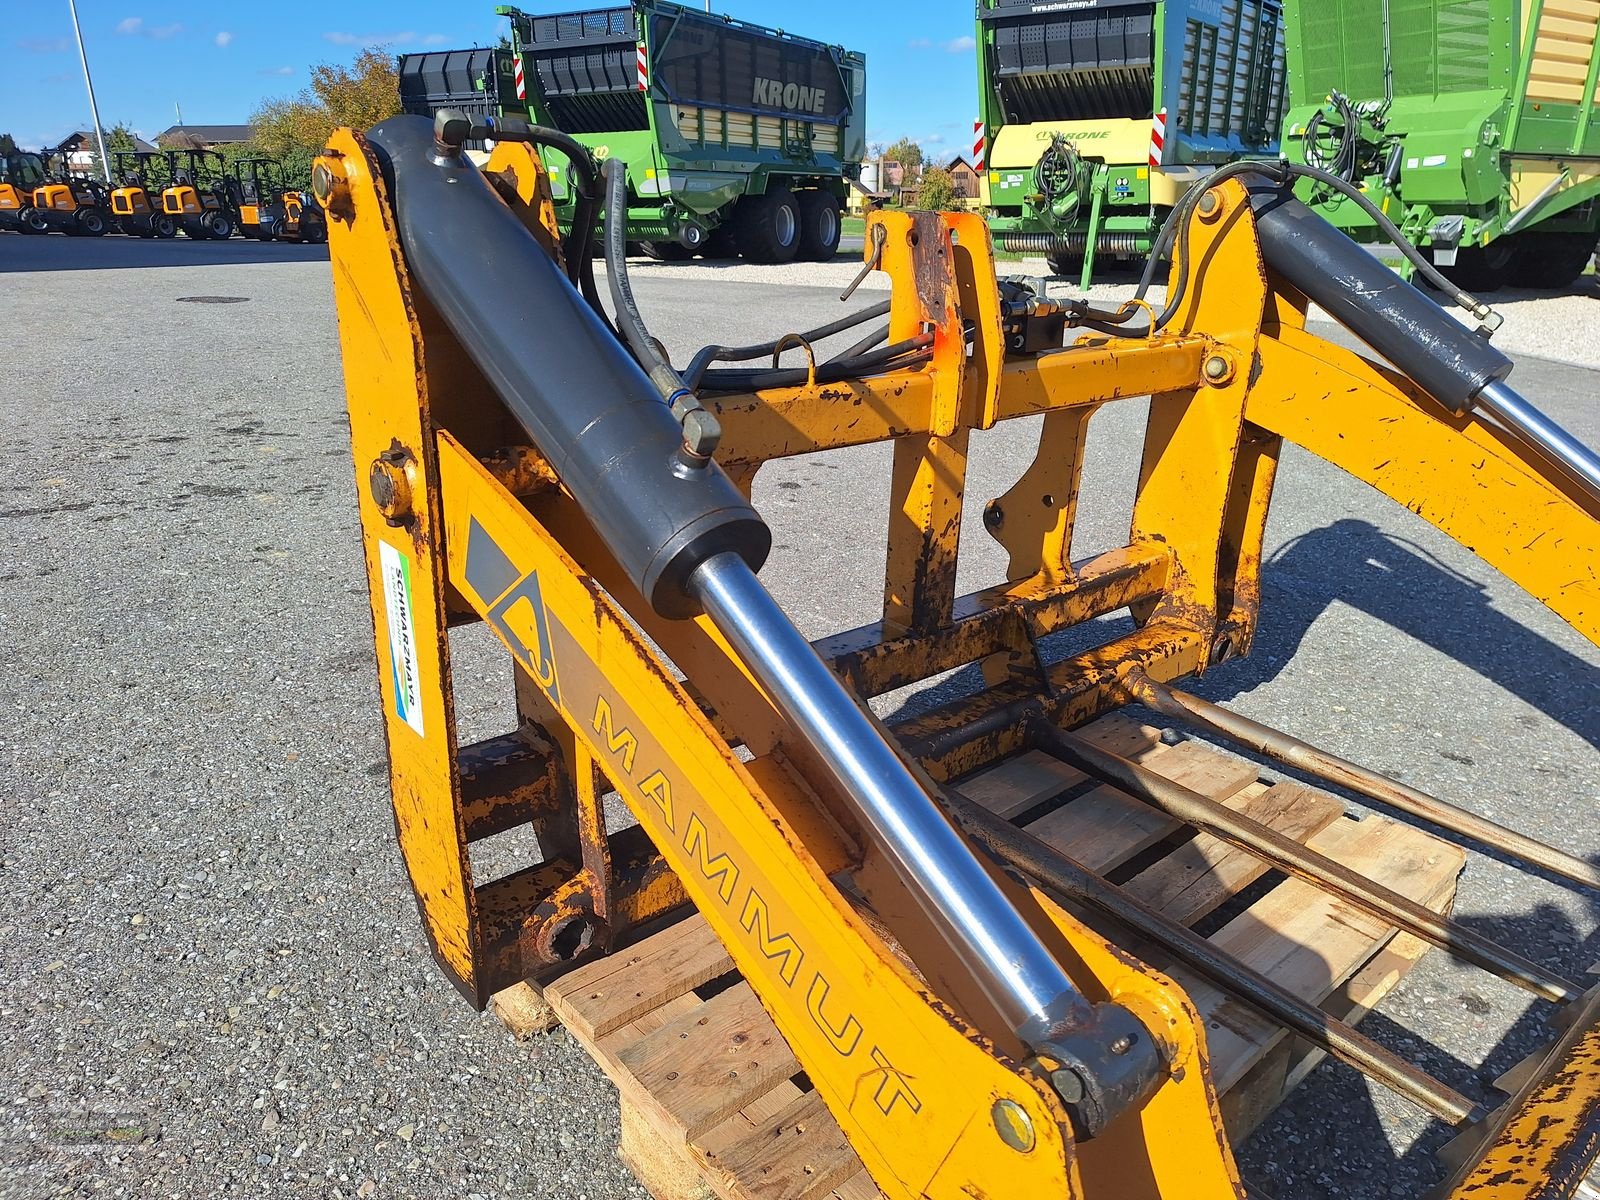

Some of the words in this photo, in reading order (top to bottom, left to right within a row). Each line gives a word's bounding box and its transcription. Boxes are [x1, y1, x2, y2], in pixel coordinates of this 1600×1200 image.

[752, 77, 826, 114] KRONE
[1059, 130, 1111, 141] RONE
[389, 565, 403, 646] LANDTECHNIK
[395, 568, 416, 706] SCHWARZMAYR
[590, 694, 922, 1117] MAMMUT
